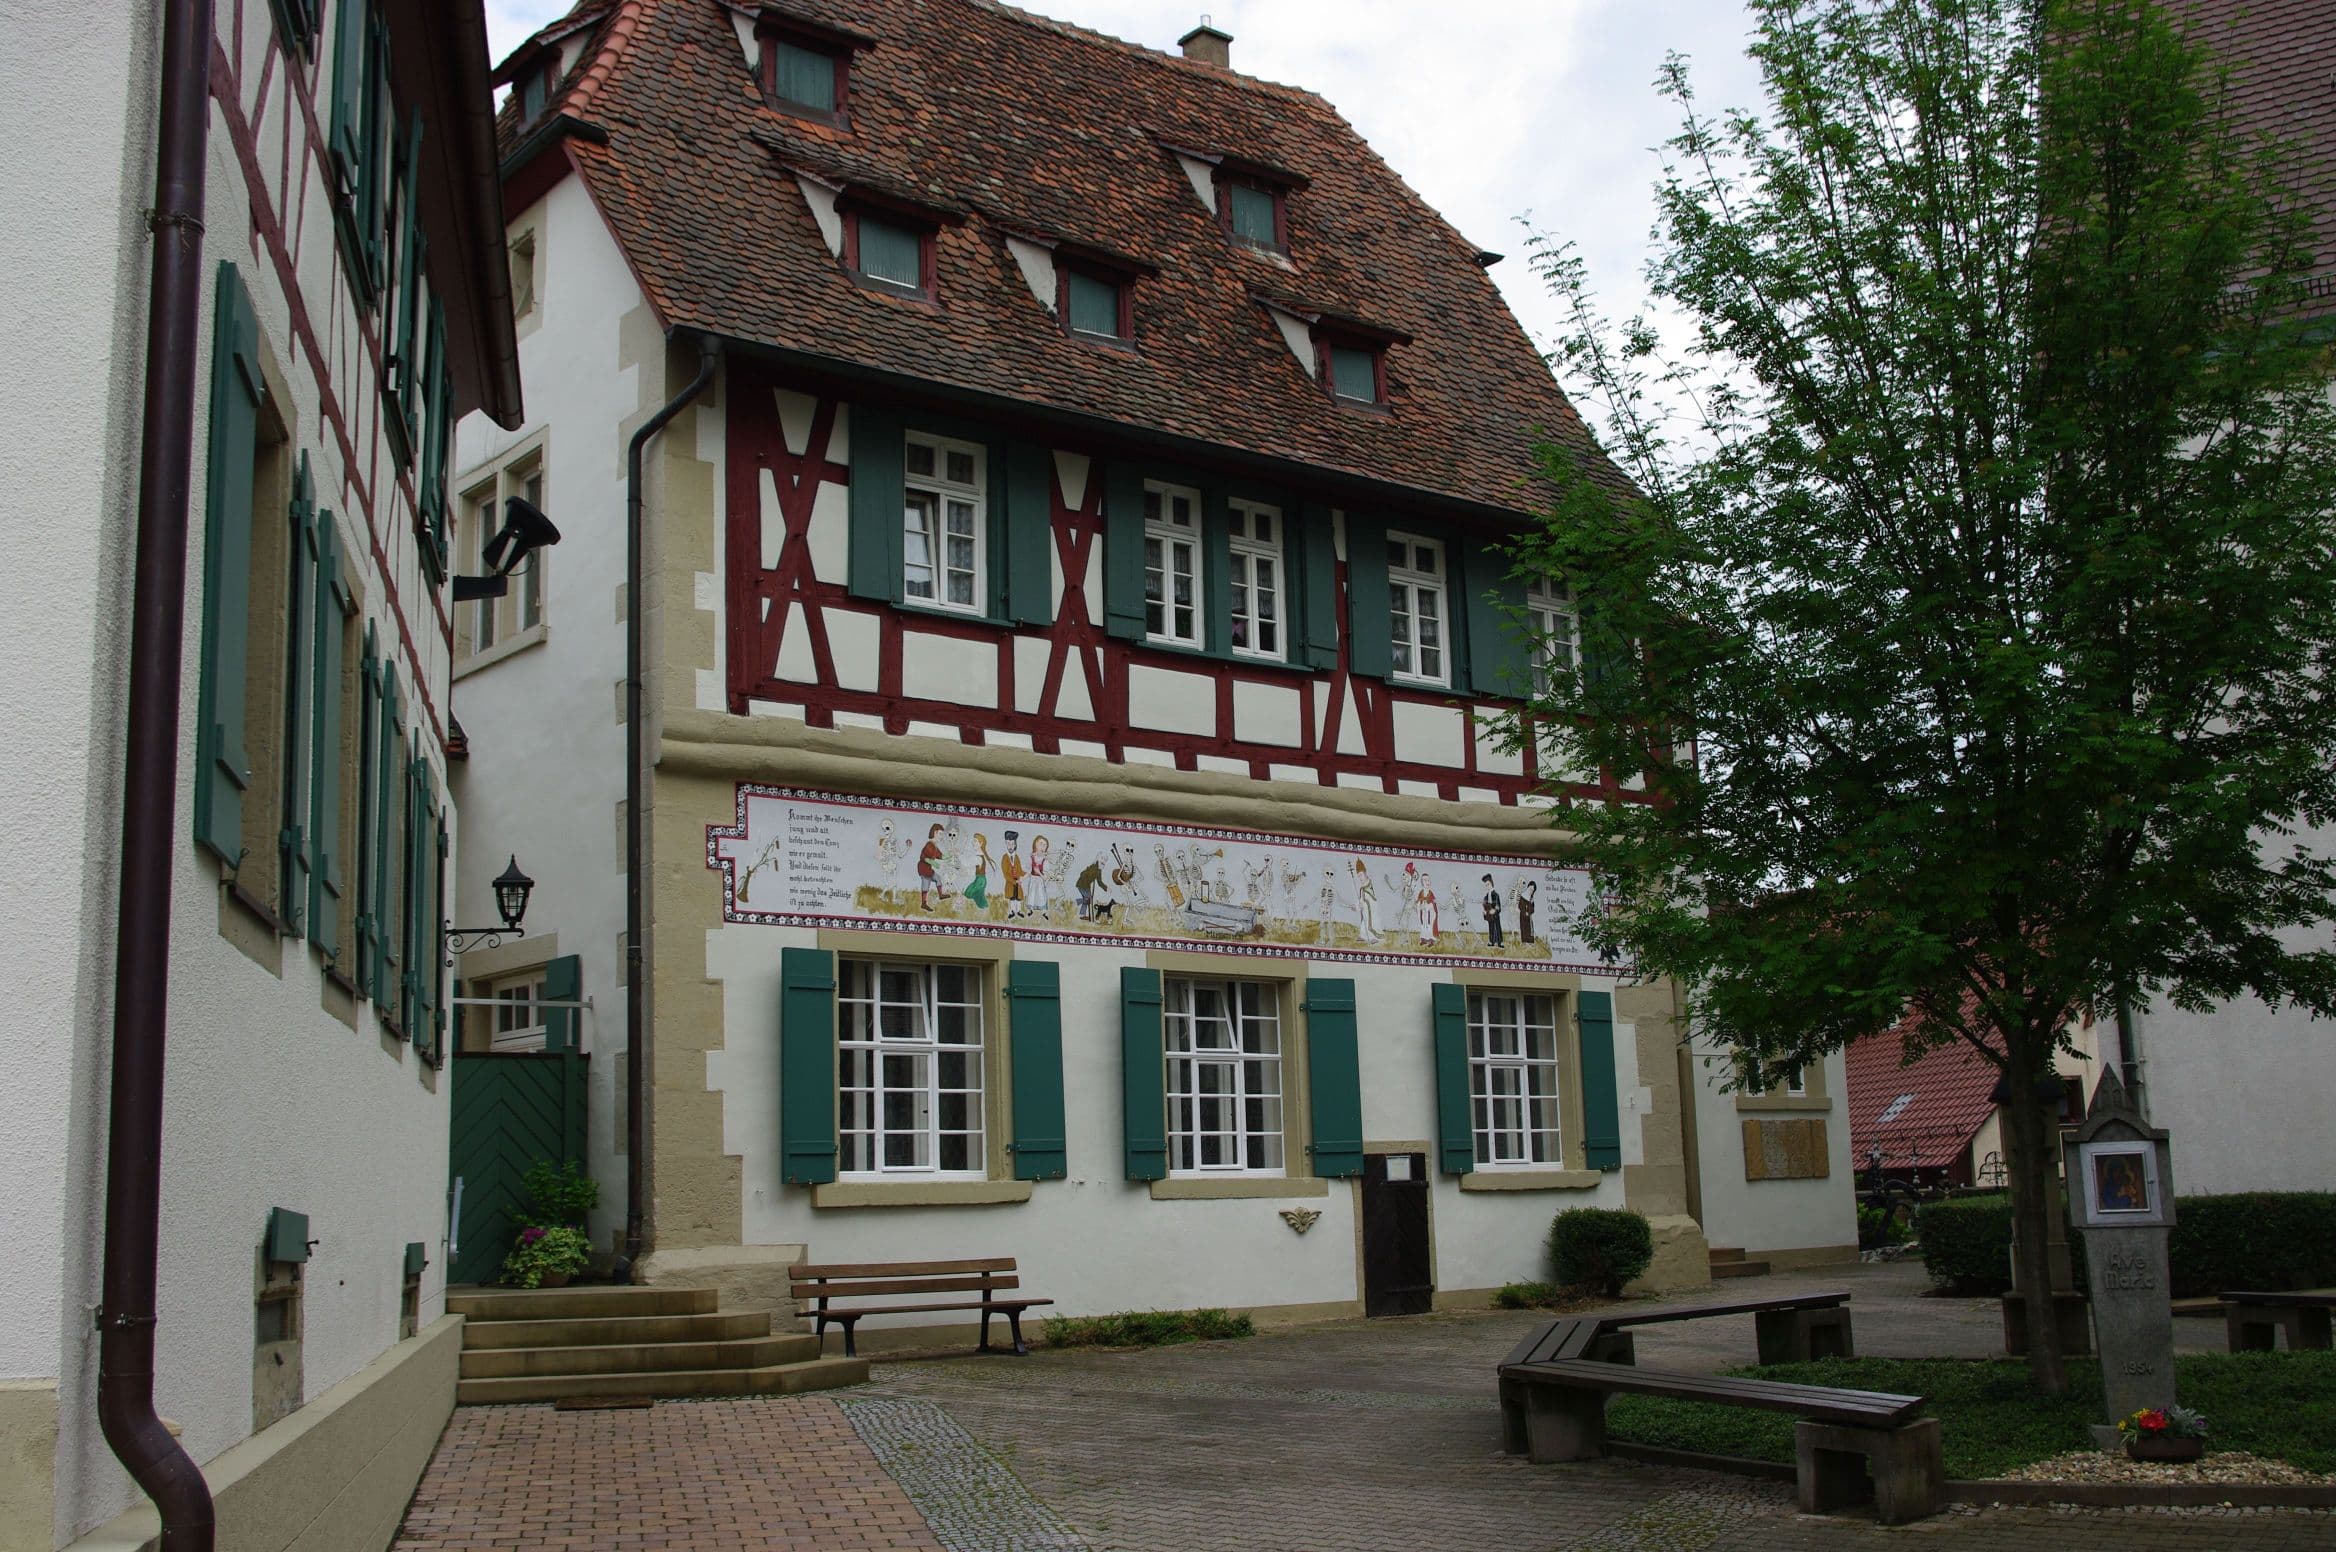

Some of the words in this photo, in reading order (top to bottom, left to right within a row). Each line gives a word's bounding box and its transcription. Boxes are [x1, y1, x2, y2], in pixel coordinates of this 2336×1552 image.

[2110, 1253, 2146, 1270] Ave
[2105, 1272, 2154, 1290] Maria
[2121, 1360, 2153, 1376] 1954
